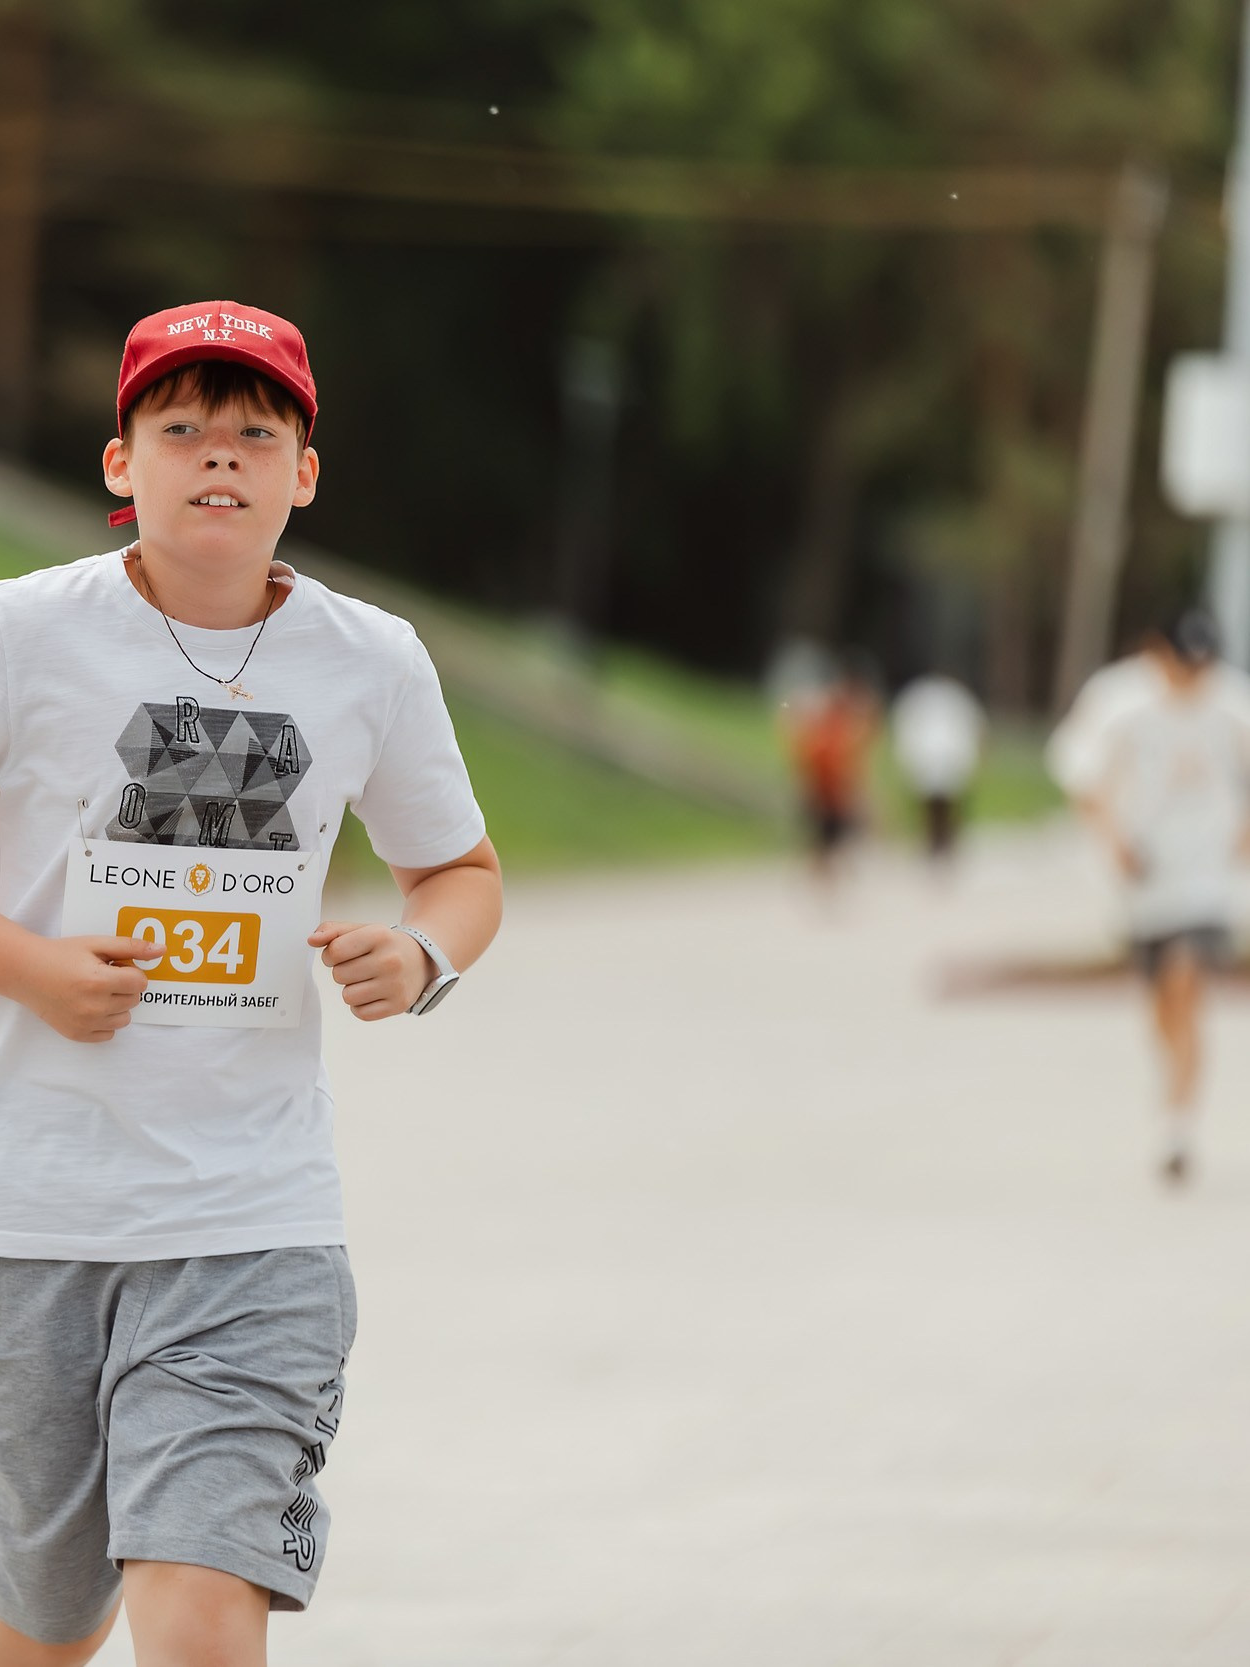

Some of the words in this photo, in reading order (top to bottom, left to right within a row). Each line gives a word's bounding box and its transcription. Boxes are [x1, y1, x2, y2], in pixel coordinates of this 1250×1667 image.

[167, 313, 213, 336] NEW
[219, 313, 274, 341] YORK
[202, 328, 236, 342] N.Y.
[176, 696, 200, 744] R
[275, 724, 300, 774] A
[89, 863, 176, 890] LEONE
[222, 873, 295, 895] D'ORO
[131, 916, 244, 975] 034
[240, 996, 280, 1009] ЗАБЕГ
